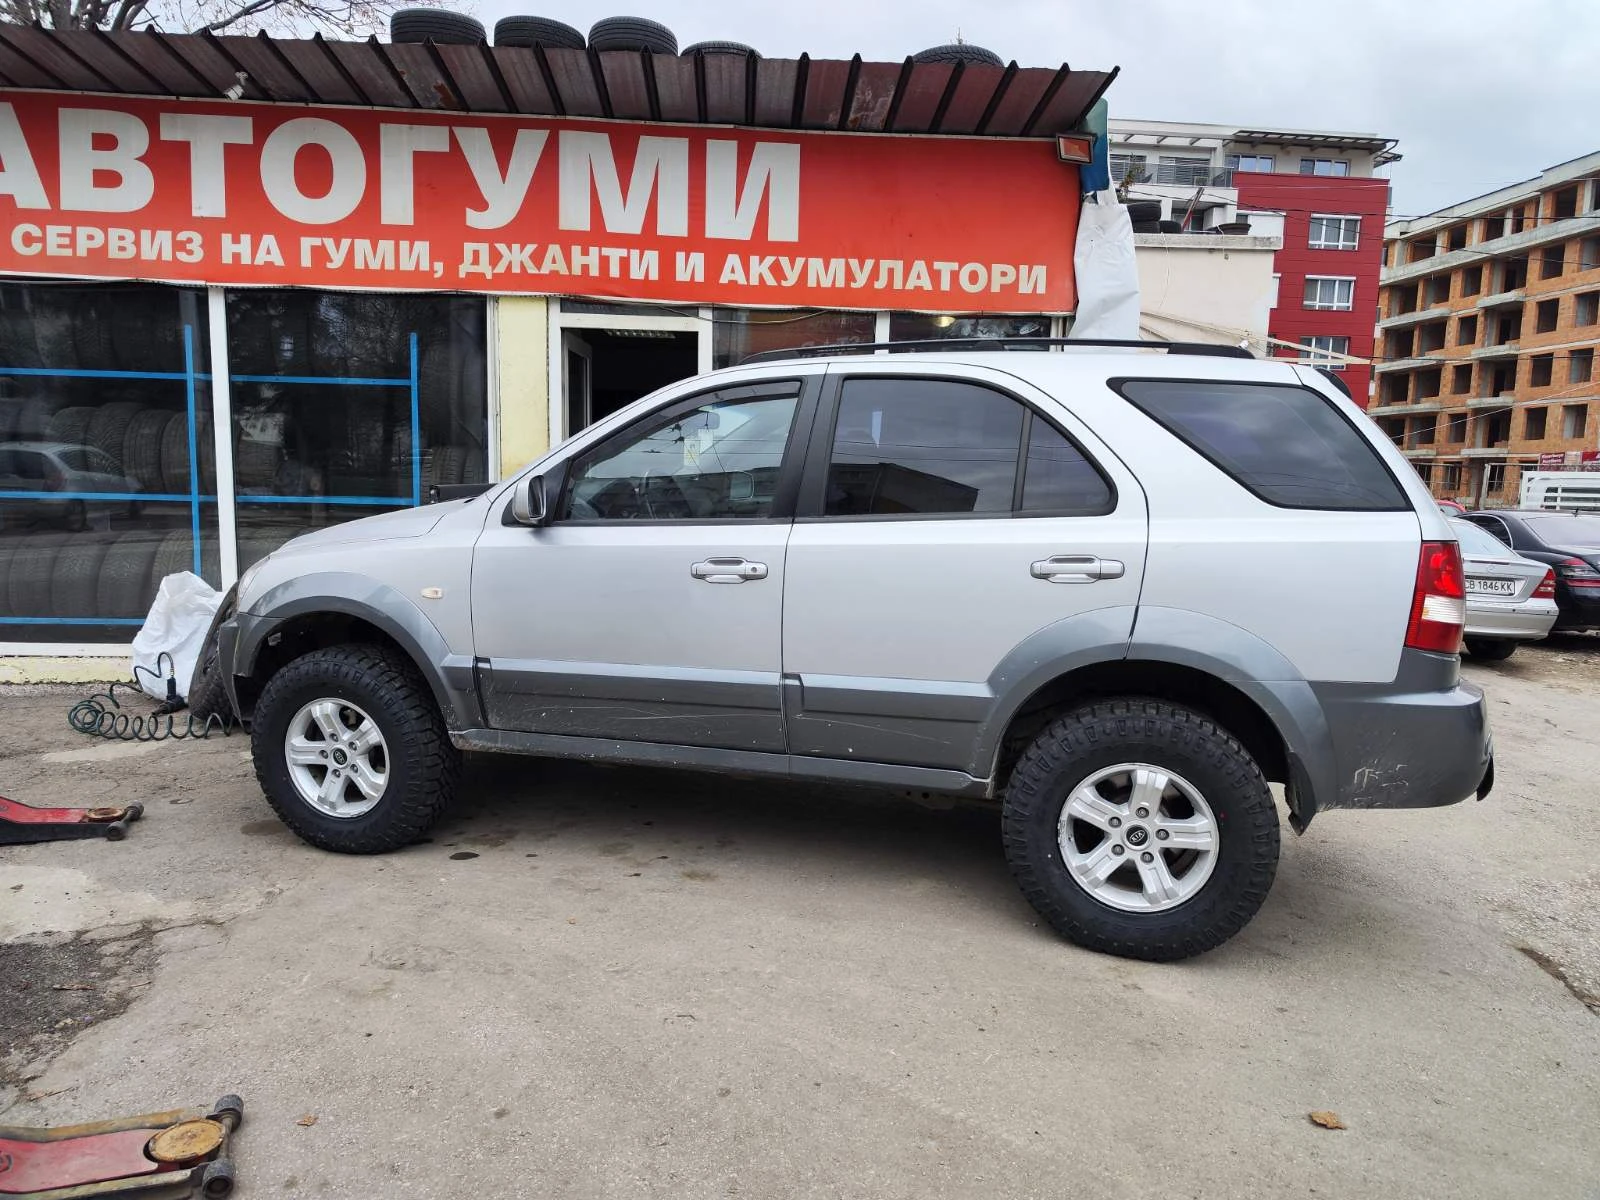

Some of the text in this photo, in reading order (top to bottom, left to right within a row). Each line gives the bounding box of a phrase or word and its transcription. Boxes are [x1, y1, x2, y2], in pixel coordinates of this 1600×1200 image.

[10, 222, 1048, 296] СЕРВИЗ НА ГУМИ, ДЖАНТИ И АКУМУЛАТОРИ
